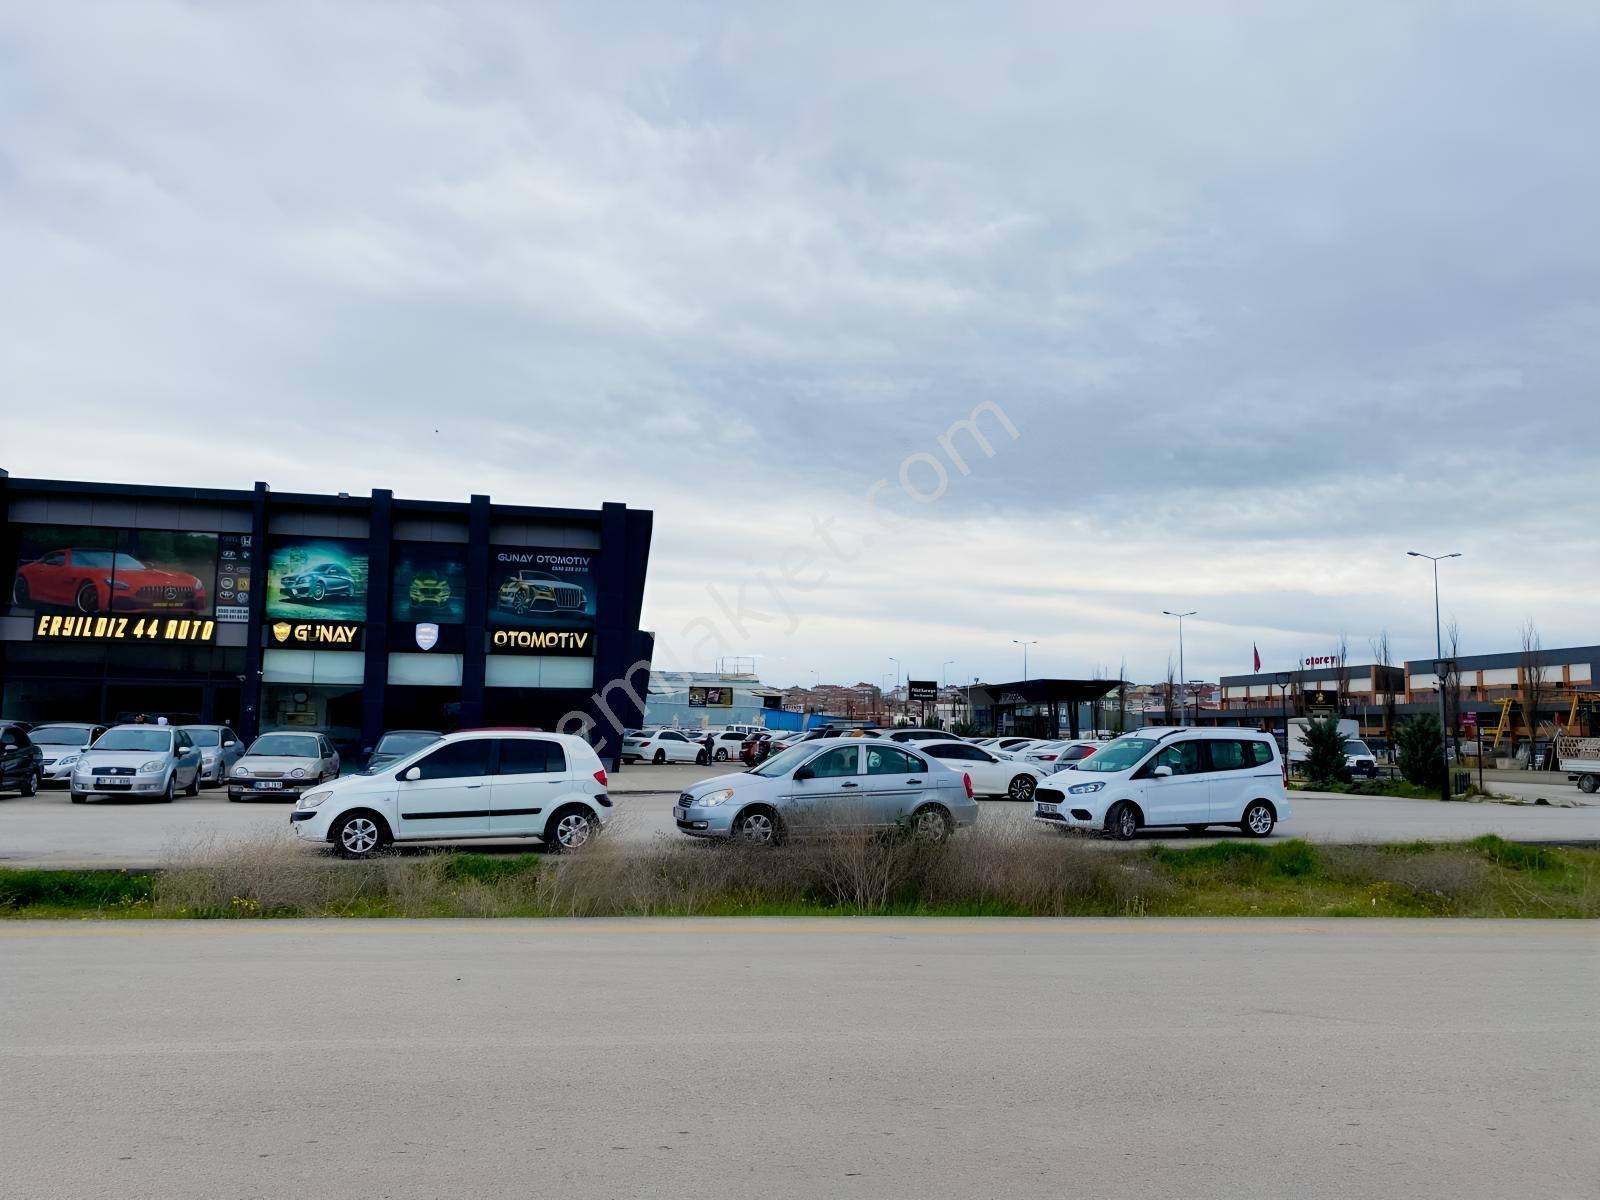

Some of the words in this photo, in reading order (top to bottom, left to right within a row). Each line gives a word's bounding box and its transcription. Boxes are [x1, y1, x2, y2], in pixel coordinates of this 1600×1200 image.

[37, 615, 129, 638] ERYILDIZ
[133, 618, 158, 639] 44
[164, 619, 214, 641] AUTO
